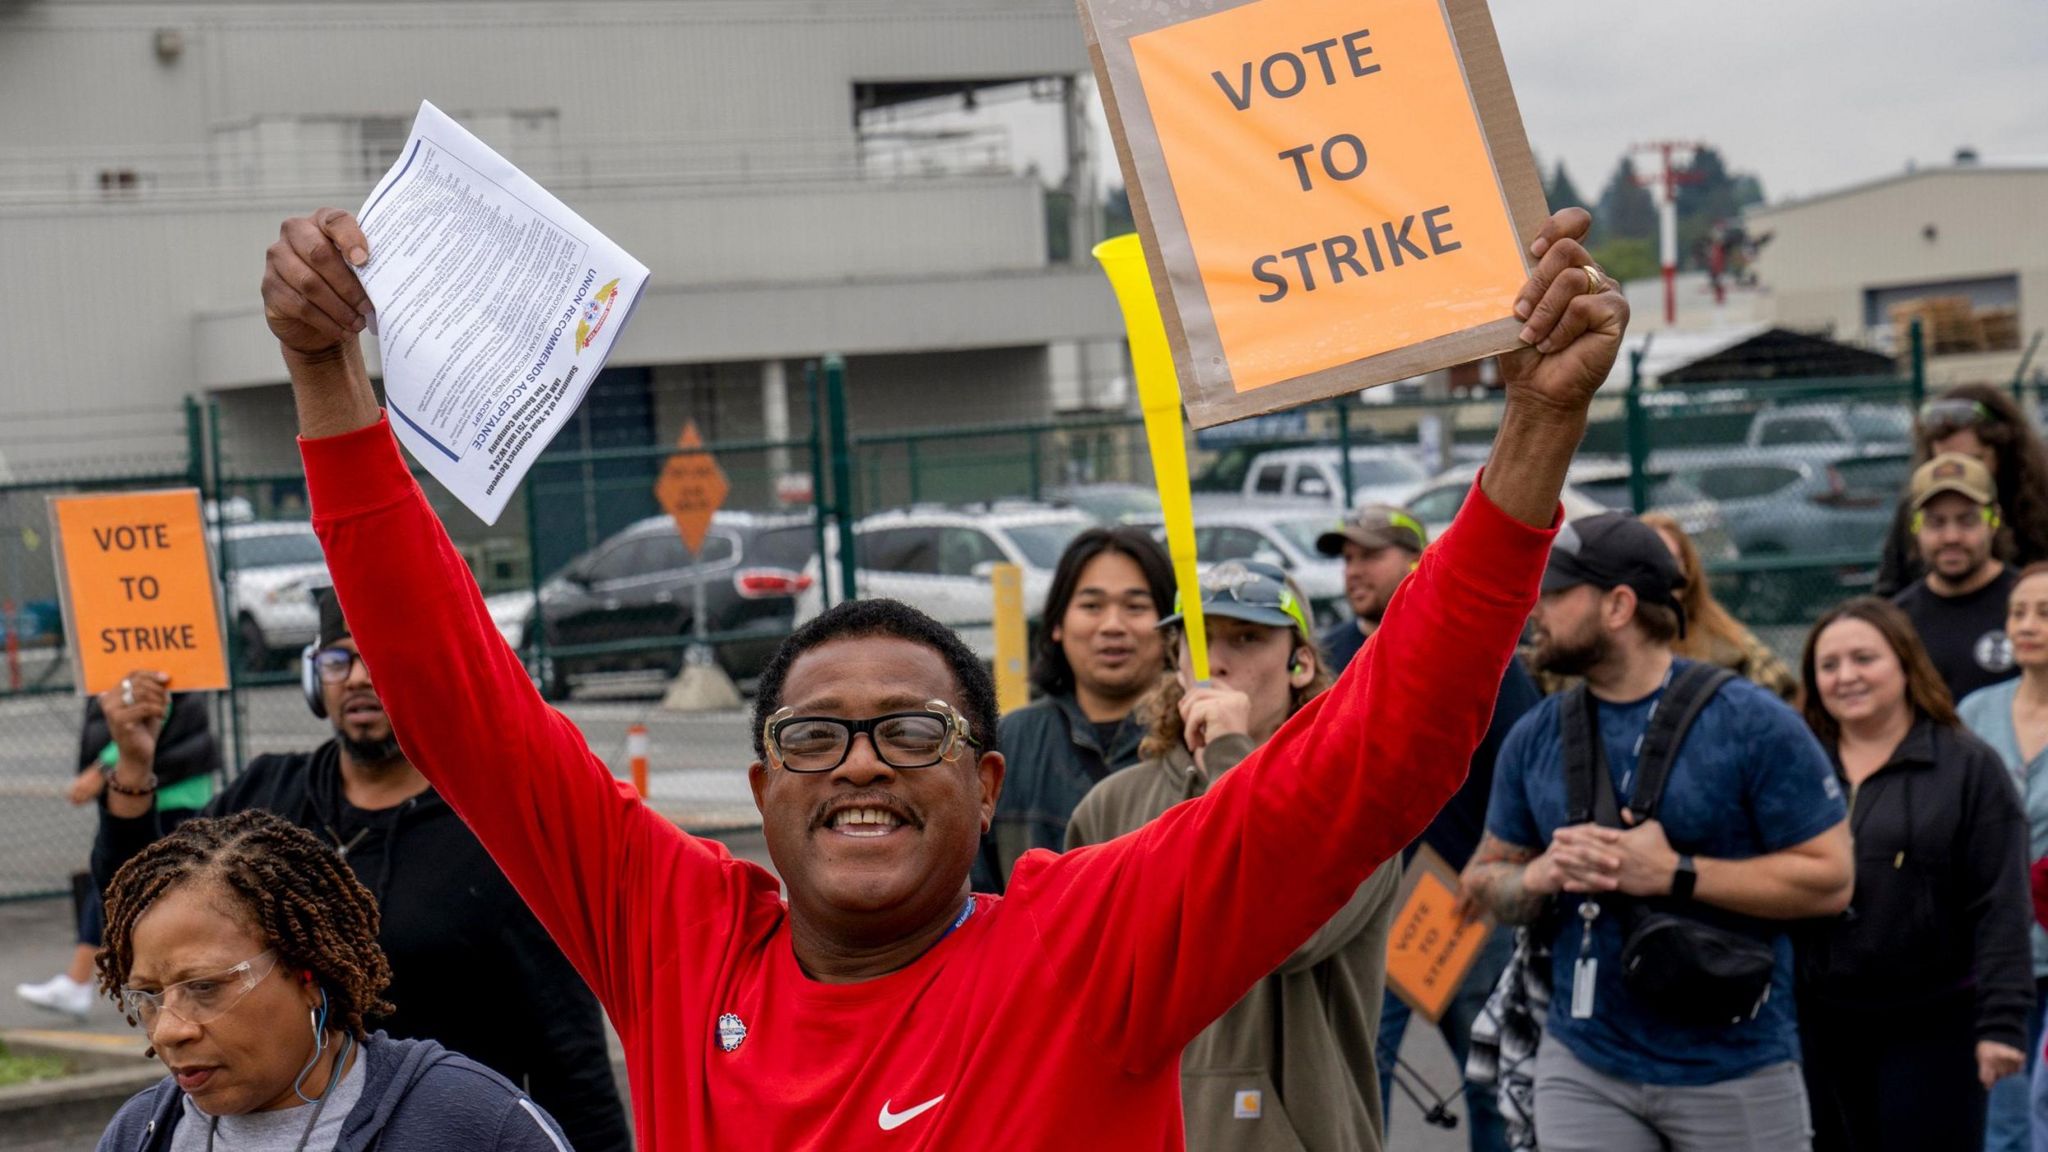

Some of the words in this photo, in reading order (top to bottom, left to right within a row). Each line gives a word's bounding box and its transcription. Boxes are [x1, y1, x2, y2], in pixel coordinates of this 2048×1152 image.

[1212, 29, 1380, 110] VOTE
[1278, 134, 1368, 192] TO
[1251, 205, 1462, 303] STRIKE
[564, 263, 577, 284] YOUR
[573, 268, 596, 304] UNION
[538, 284, 567, 331] NEGOTIATING
[526, 305, 575, 382] RECOMMENDS
[528, 332, 541, 352] TEAM
[533, 383, 547, 396] The
[549, 377, 561, 393] IAM
[554, 365, 578, 401] Summary
[472, 398, 491, 426] ACCEPT
[472, 381, 526, 449] ACCEPTANCE
[512, 396, 536, 420] Boeing
[524, 392, 551, 421] Districts
[547, 400, 556, 411] of
[514, 421, 527, 434] 751
[530, 409, 550, 432] 4-Year
[488, 420, 515, 454] Company
[504, 432, 516, 448] and
[506, 431, 532, 463] Contract
[488, 463, 496, 471] &
[493, 448, 507, 465] W24
[486, 462, 509, 495] Between
[93, 524, 170, 551] VOTE
[120, 575, 160, 601] TO
[101, 625, 196, 653] STRIKE
[1395, 901, 1430, 950] VOTE
[1418, 928, 1439, 953] TO
